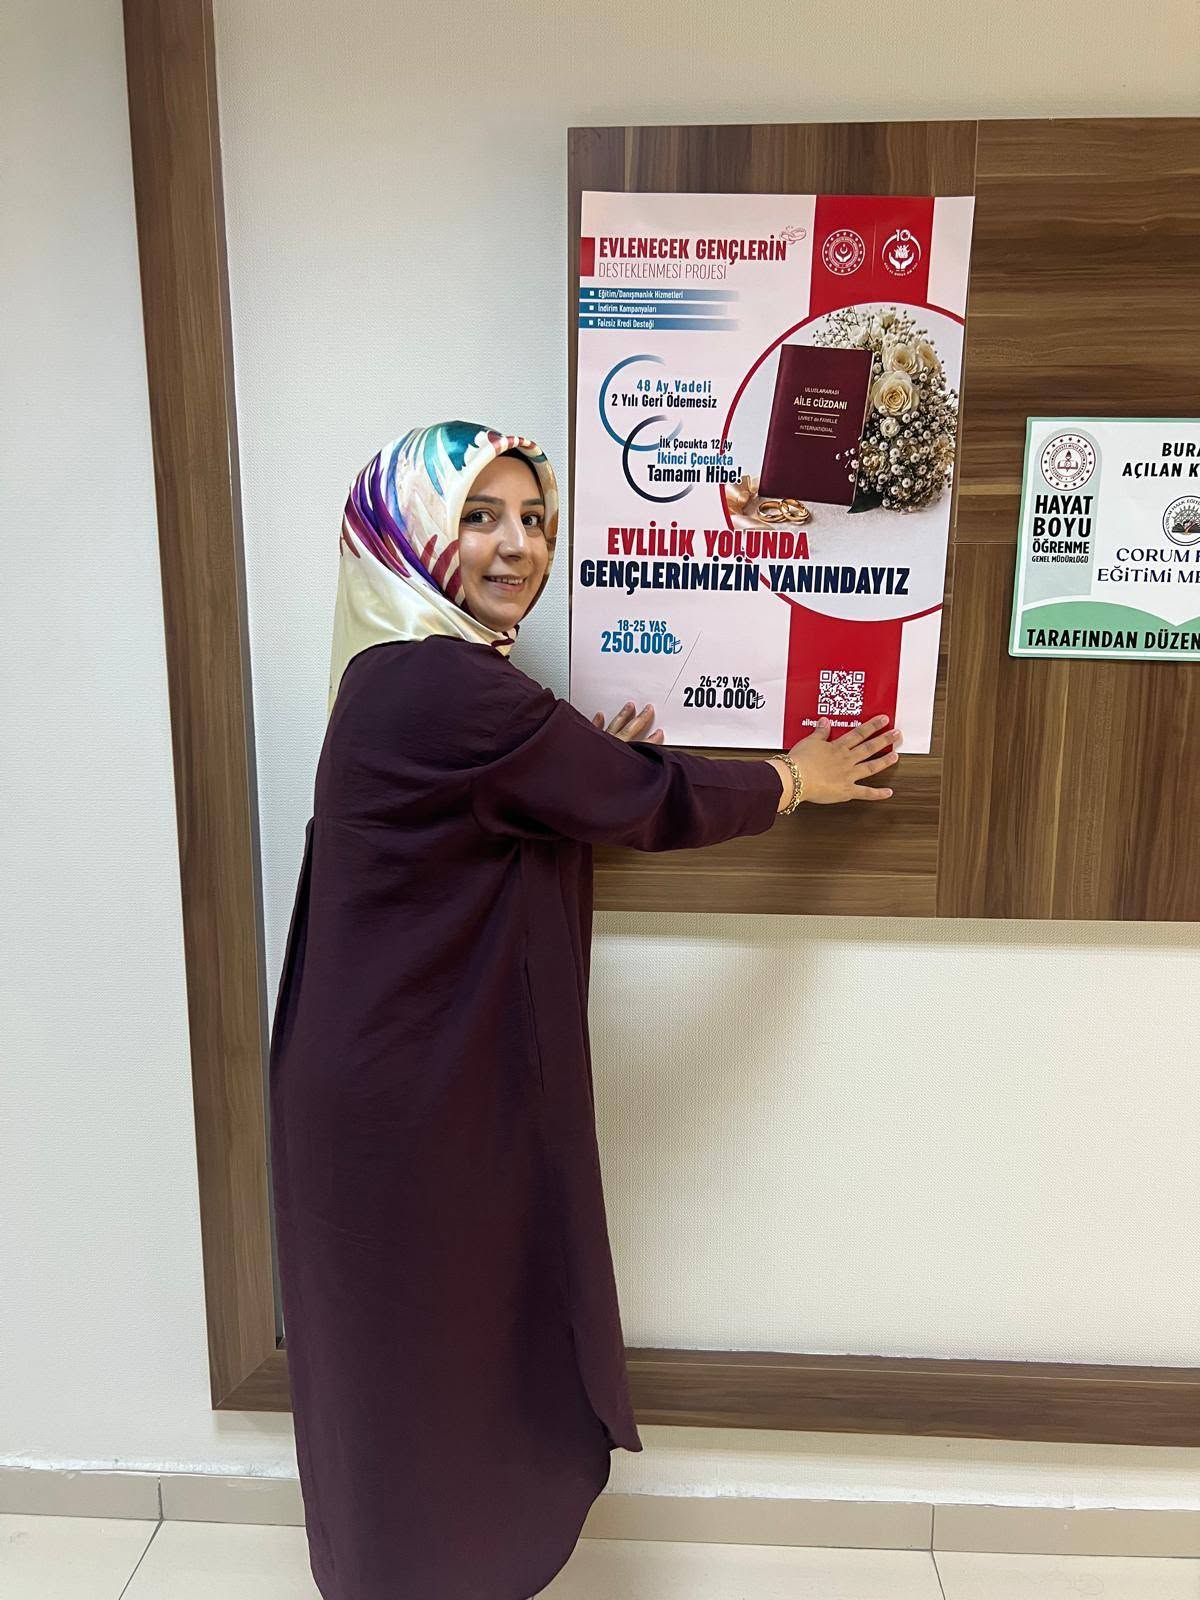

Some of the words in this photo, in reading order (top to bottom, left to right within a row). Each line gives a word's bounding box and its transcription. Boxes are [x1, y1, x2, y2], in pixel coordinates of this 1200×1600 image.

[599, 237, 690, 260] EVLENECEK
[695, 234, 788, 266] GENÇLERİN
[598, 260, 682, 279] DESTEKLENMESİ
[685, 261, 727, 280] PROJESİ
[598, 289, 653, 299] Eğitim/Danışmanlık
[654, 290, 684, 299] Hizmetleri
[597, 303, 618, 312] İndirim
[619, 304, 657, 314] Kampanyaları
[597, 318, 616, 328] Faizsiz
[616, 319, 632, 328] Kredi
[633, 319, 655, 330] Desteği
[636, 379, 651, 392] 48
[655, 380, 669, 395] Ay
[674, 380, 712, 393] Vadeli
[804, 387, 840, 395] ULUSLARARASI
[611, 393, 618, 407] 2
[621, 394, 638, 407] Yılı
[642, 394, 663, 408] Geri
[666, 391, 718, 409] Ödemesiz
[793, 395, 811, 407] AİLE
[812, 397, 848, 410] CÜZDANI
[659, 435, 671, 449] İlk
[673, 438, 708, 451] Çocukta
[710, 439, 720, 450] 12
[723, 440, 733, 451] Ay
[657, 449, 687, 465] İkinci
[690, 452, 734, 468] Çocukta
[647, 464, 701, 483] Tamamı
[705, 466, 742, 483] Hibe!
[1122, 462, 1182, 479] AÇILAN
[1034, 494, 1094, 515] HAYAT
[1032, 517, 1092, 538] BOYU
[607, 520, 695, 558] EVLİLİK
[703, 529, 810, 560] YOLUNDA
[1032, 538, 1090, 554] ÖĞRENME
[1031, 555, 1050, 563] GENEL
[1051, 555, 1089, 564] MÜDÜRLÜĞÜ
[580, 554, 760, 596] GENÇLERİMİZİN
[768, 563, 911, 596] YANINDAYIZ
[617, 619, 646, 632] 18-25
[648, 620, 667, 635] YAŞ
[1027, 629, 1138, 649] TARAFINDAN
[699, 675, 729, 688] 26-29
[732, 676, 750, 691] YAŞ
